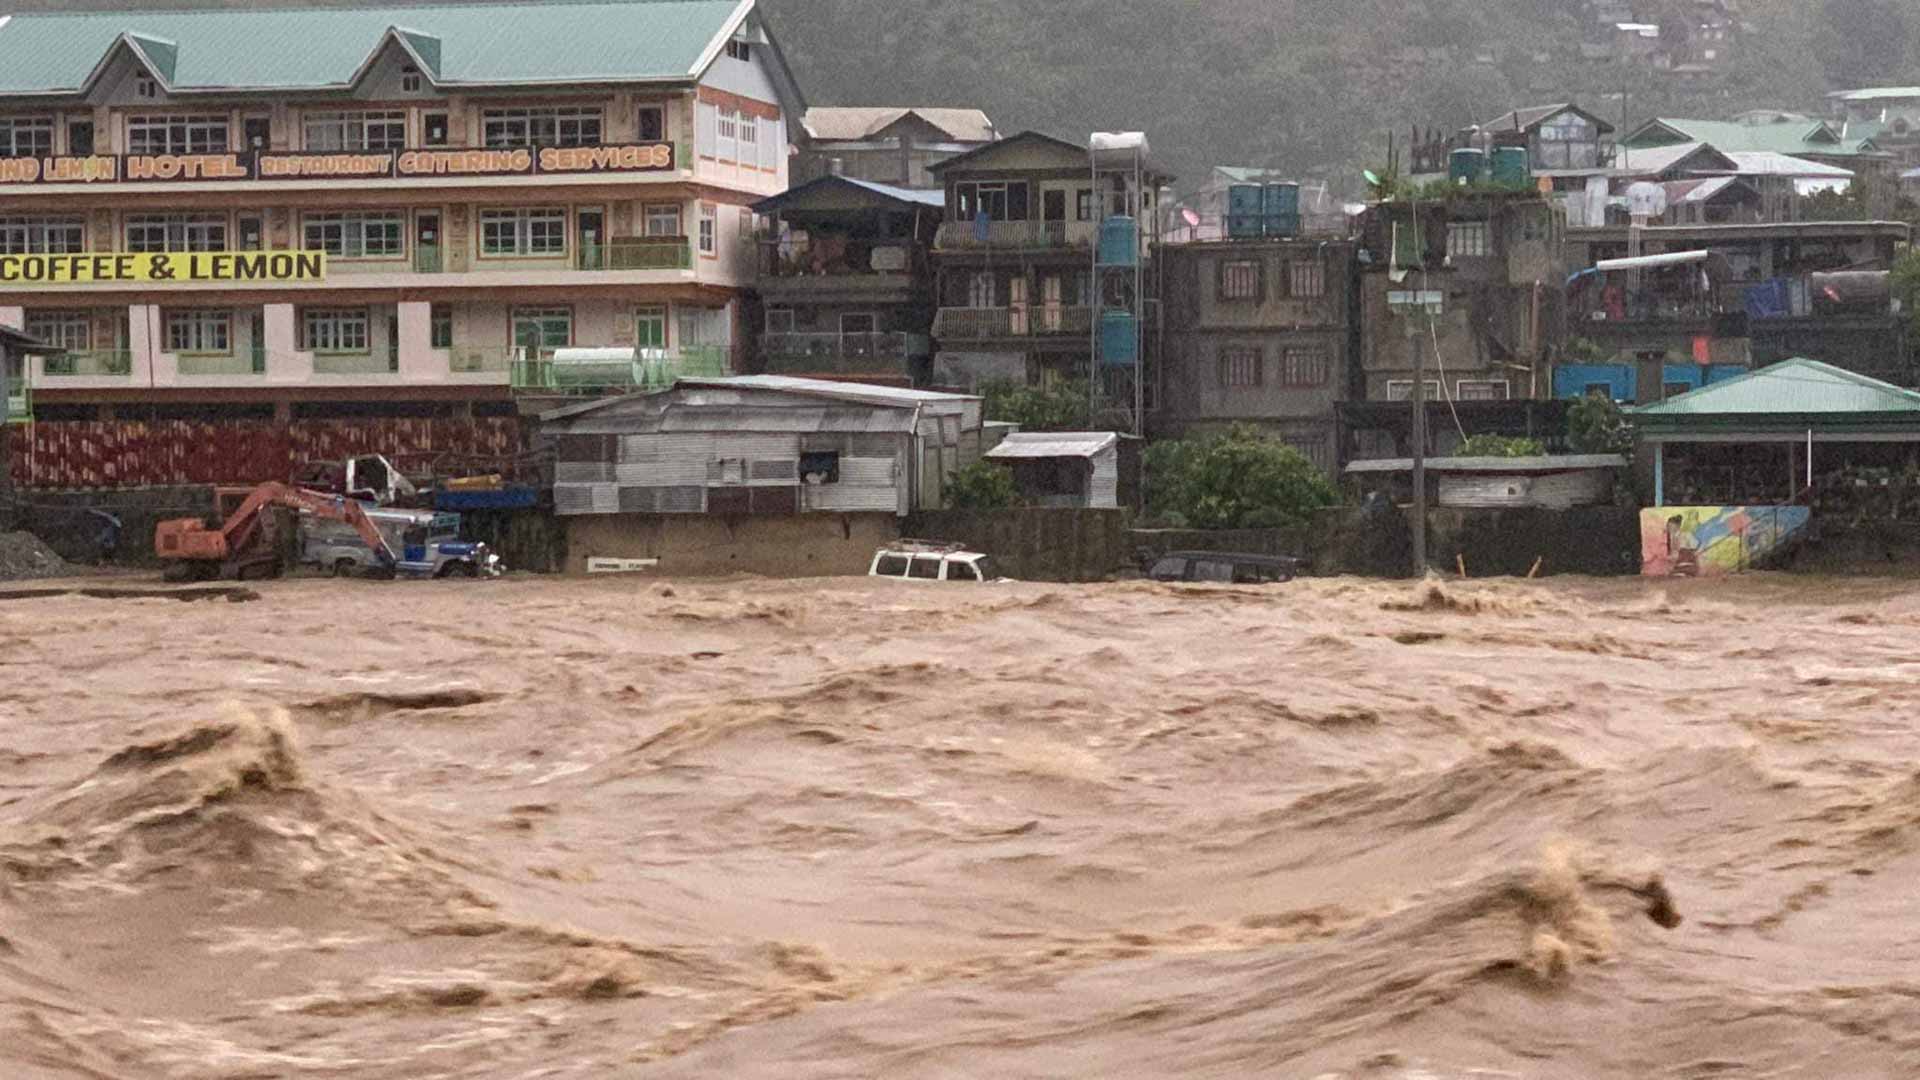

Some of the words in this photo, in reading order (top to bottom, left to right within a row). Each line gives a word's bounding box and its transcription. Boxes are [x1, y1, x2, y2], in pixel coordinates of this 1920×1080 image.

[0, 157, 40, 181] ND
[44, 155, 115, 182] LEMON
[127, 155, 248, 179] HOTEL
[260, 154, 392, 176] RESTAURANT
[398, 149, 531, 173] CATERING
[539, 144, 670, 170] SERVICES
[0, 255, 135, 280] COFFEE
[148, 255, 175, 280] &
[190, 254, 321, 279] LEMON
